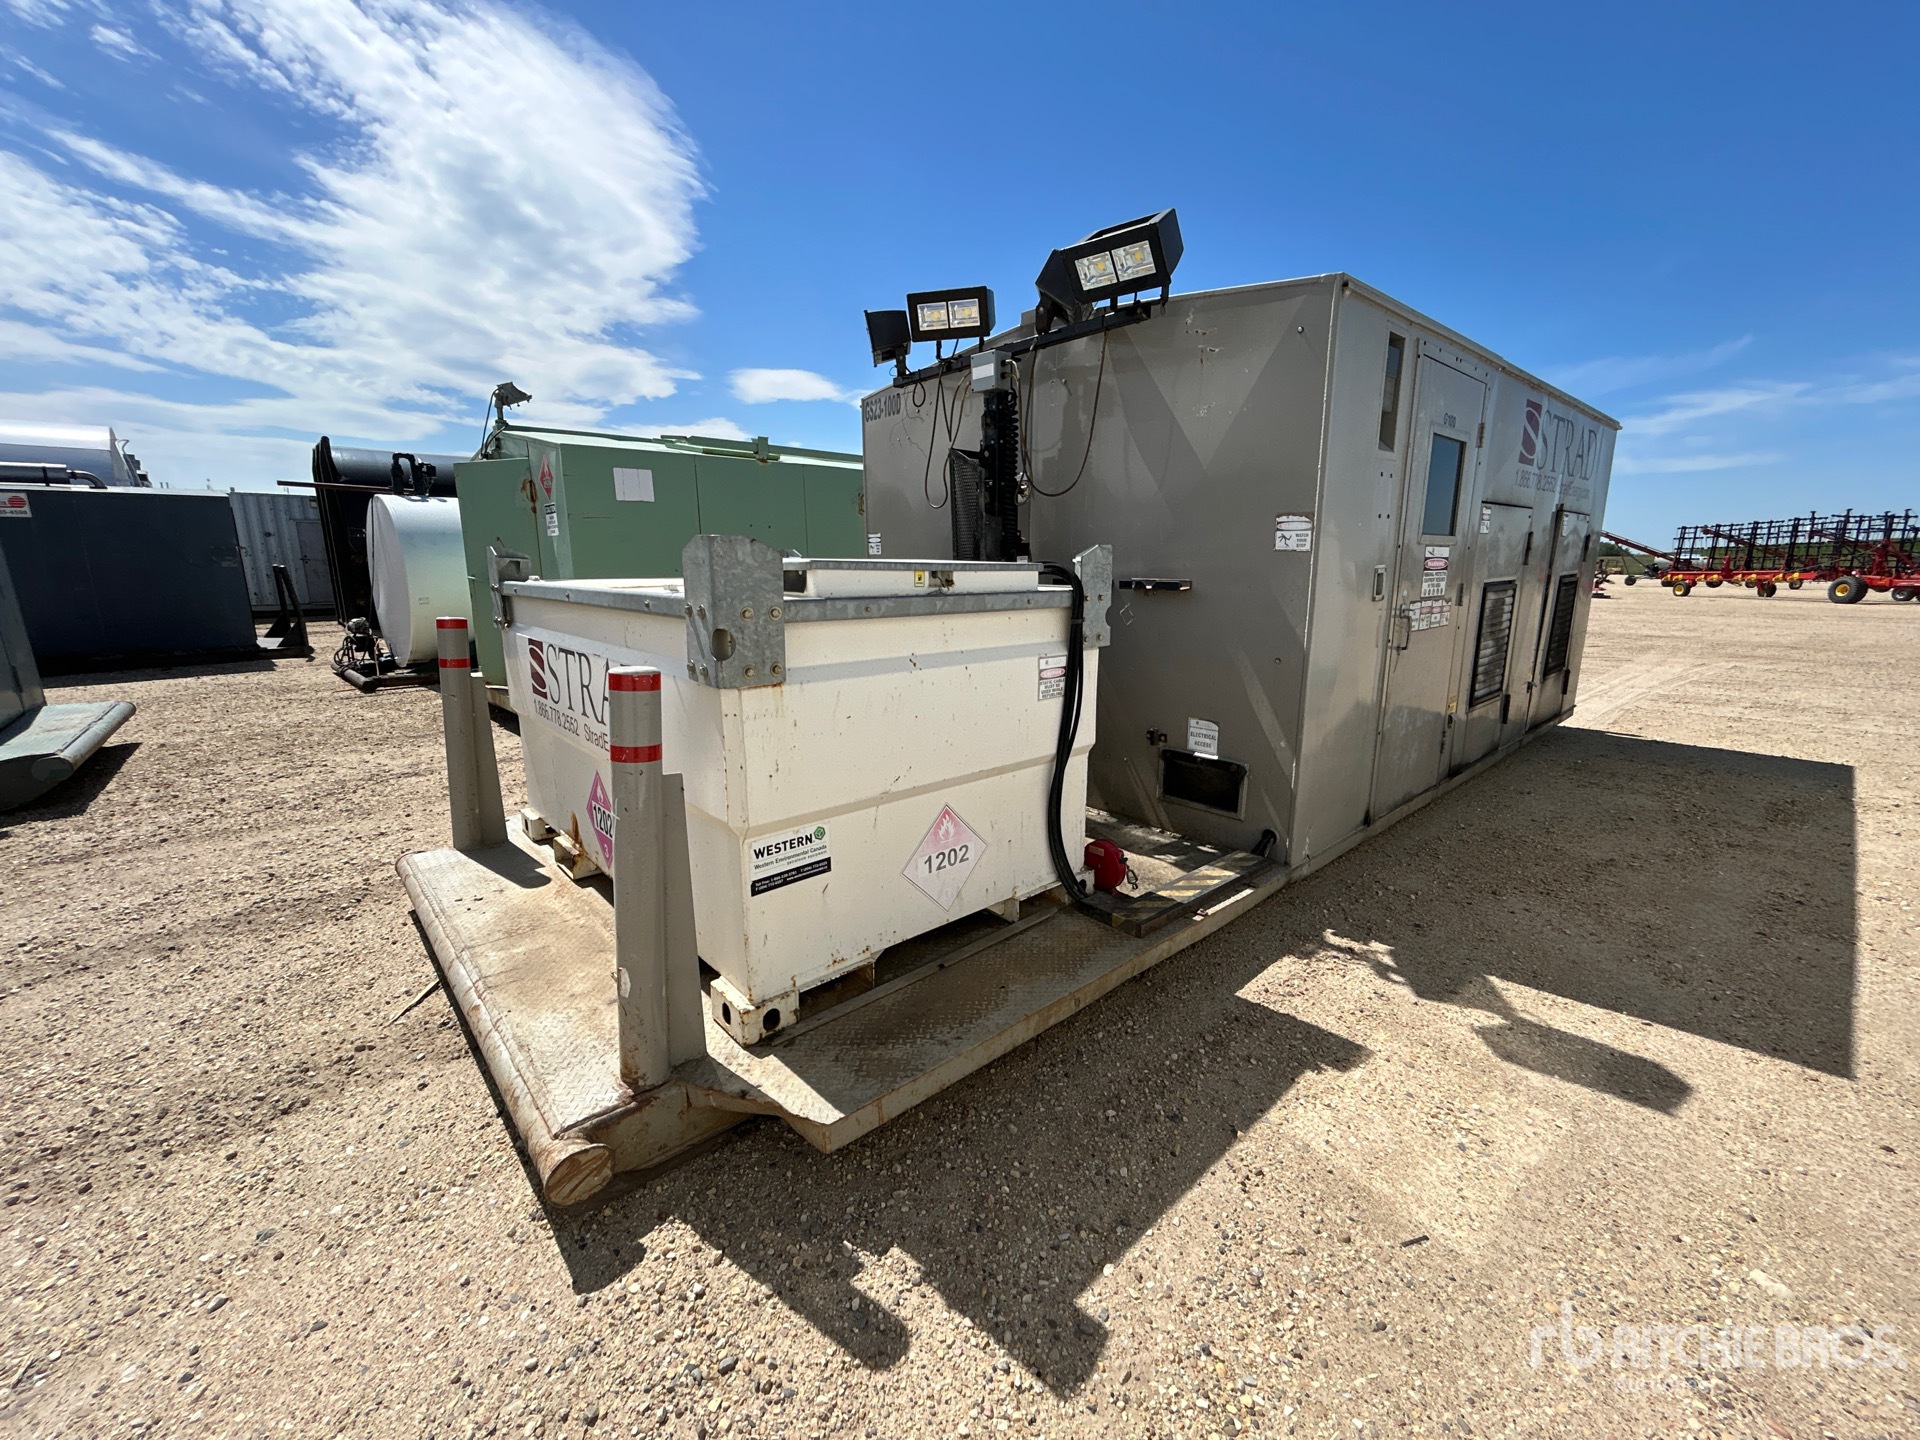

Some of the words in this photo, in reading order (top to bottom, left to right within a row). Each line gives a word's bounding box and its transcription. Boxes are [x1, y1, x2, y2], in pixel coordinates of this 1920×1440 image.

[1536, 410, 1598, 480] STRAD
[546, 644, 610, 726] STRA
[1190, 731, 1216, 741] ELECTRICAL
[594, 804, 613, 838] 1202
[604, 843, 609, 858] 3
[753, 833, 812, 859] WESTERN
[754, 860, 774, 870] Western
[776, 849, 809, 864] Environmental
[810, 845, 827, 853] Canada
[924, 844, 969, 874] 1202
